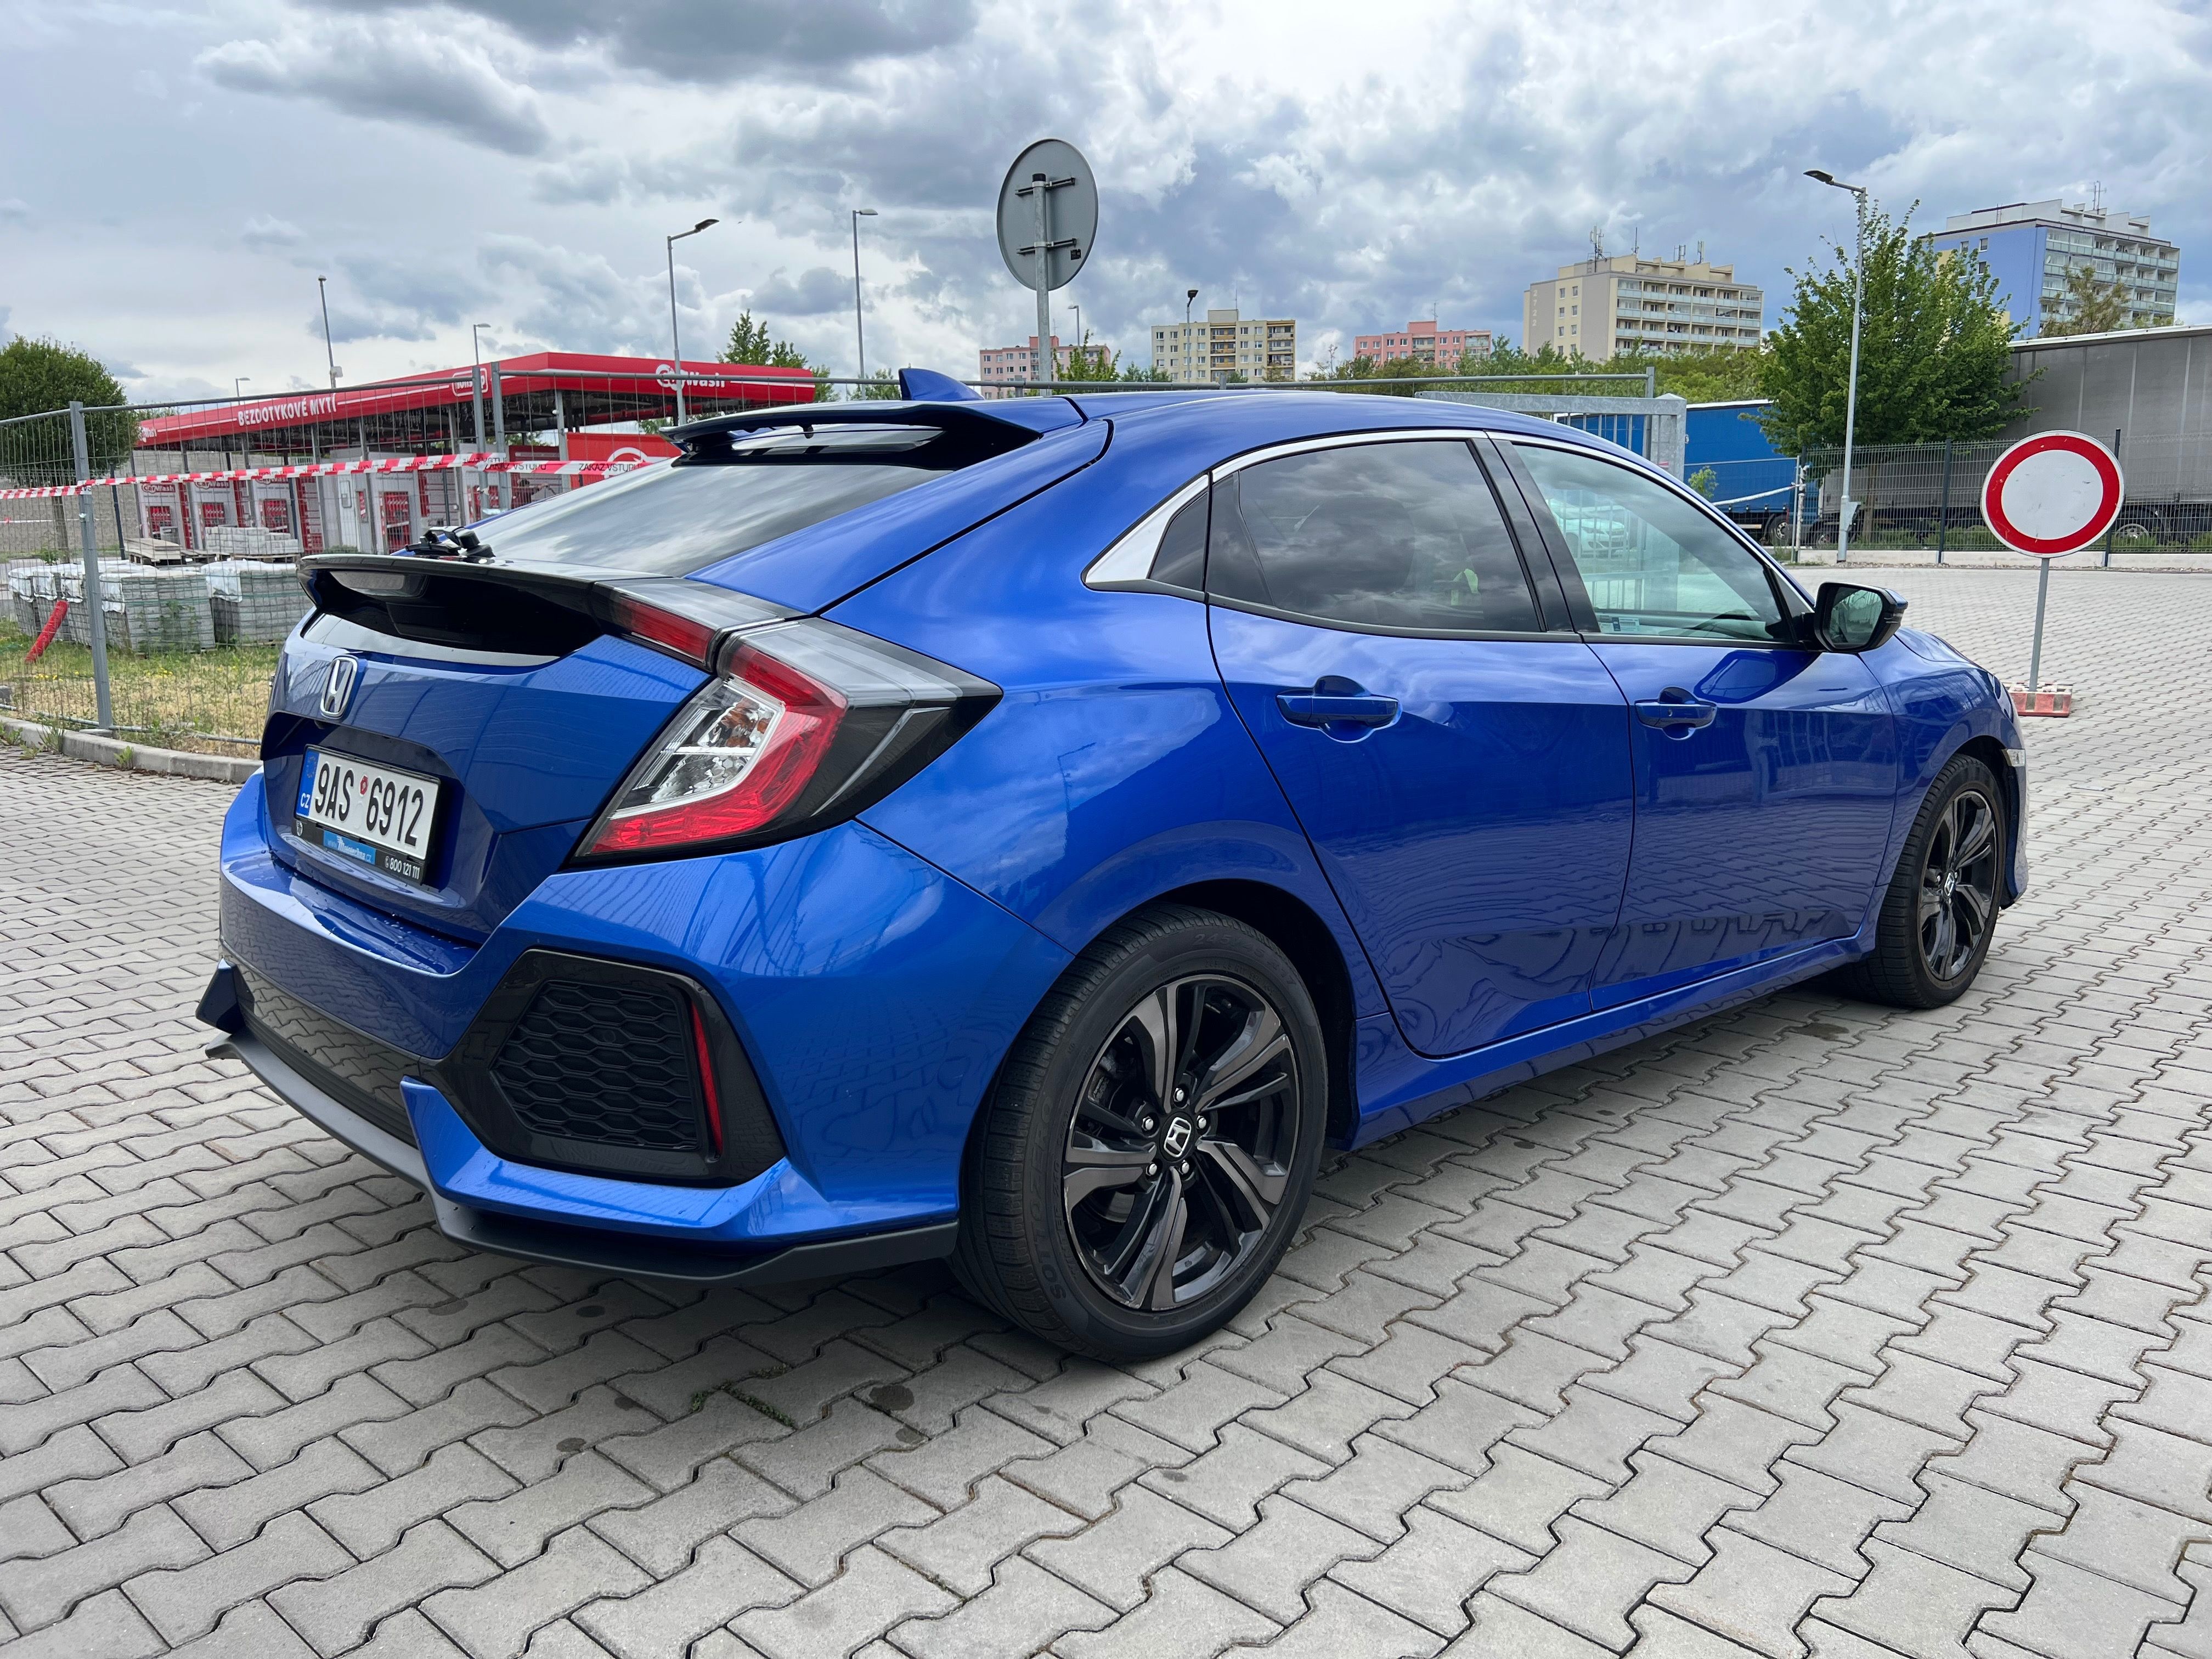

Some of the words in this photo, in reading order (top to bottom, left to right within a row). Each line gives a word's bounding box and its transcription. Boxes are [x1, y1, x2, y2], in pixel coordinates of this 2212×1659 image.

[238, 398, 308, 426] BEZDOTYKOVÉ
[309, 393, 337, 416] MYTÍ
[142, 483, 175, 493] CarWash
[300, 793, 311, 809] CZ
[314, 763, 354, 821] 9AS
[366, 776, 424, 847] 6912
[390, 857, 402, 874] 800
[403, 862, 412, 877] 121
[412, 865, 421, 880] 111
